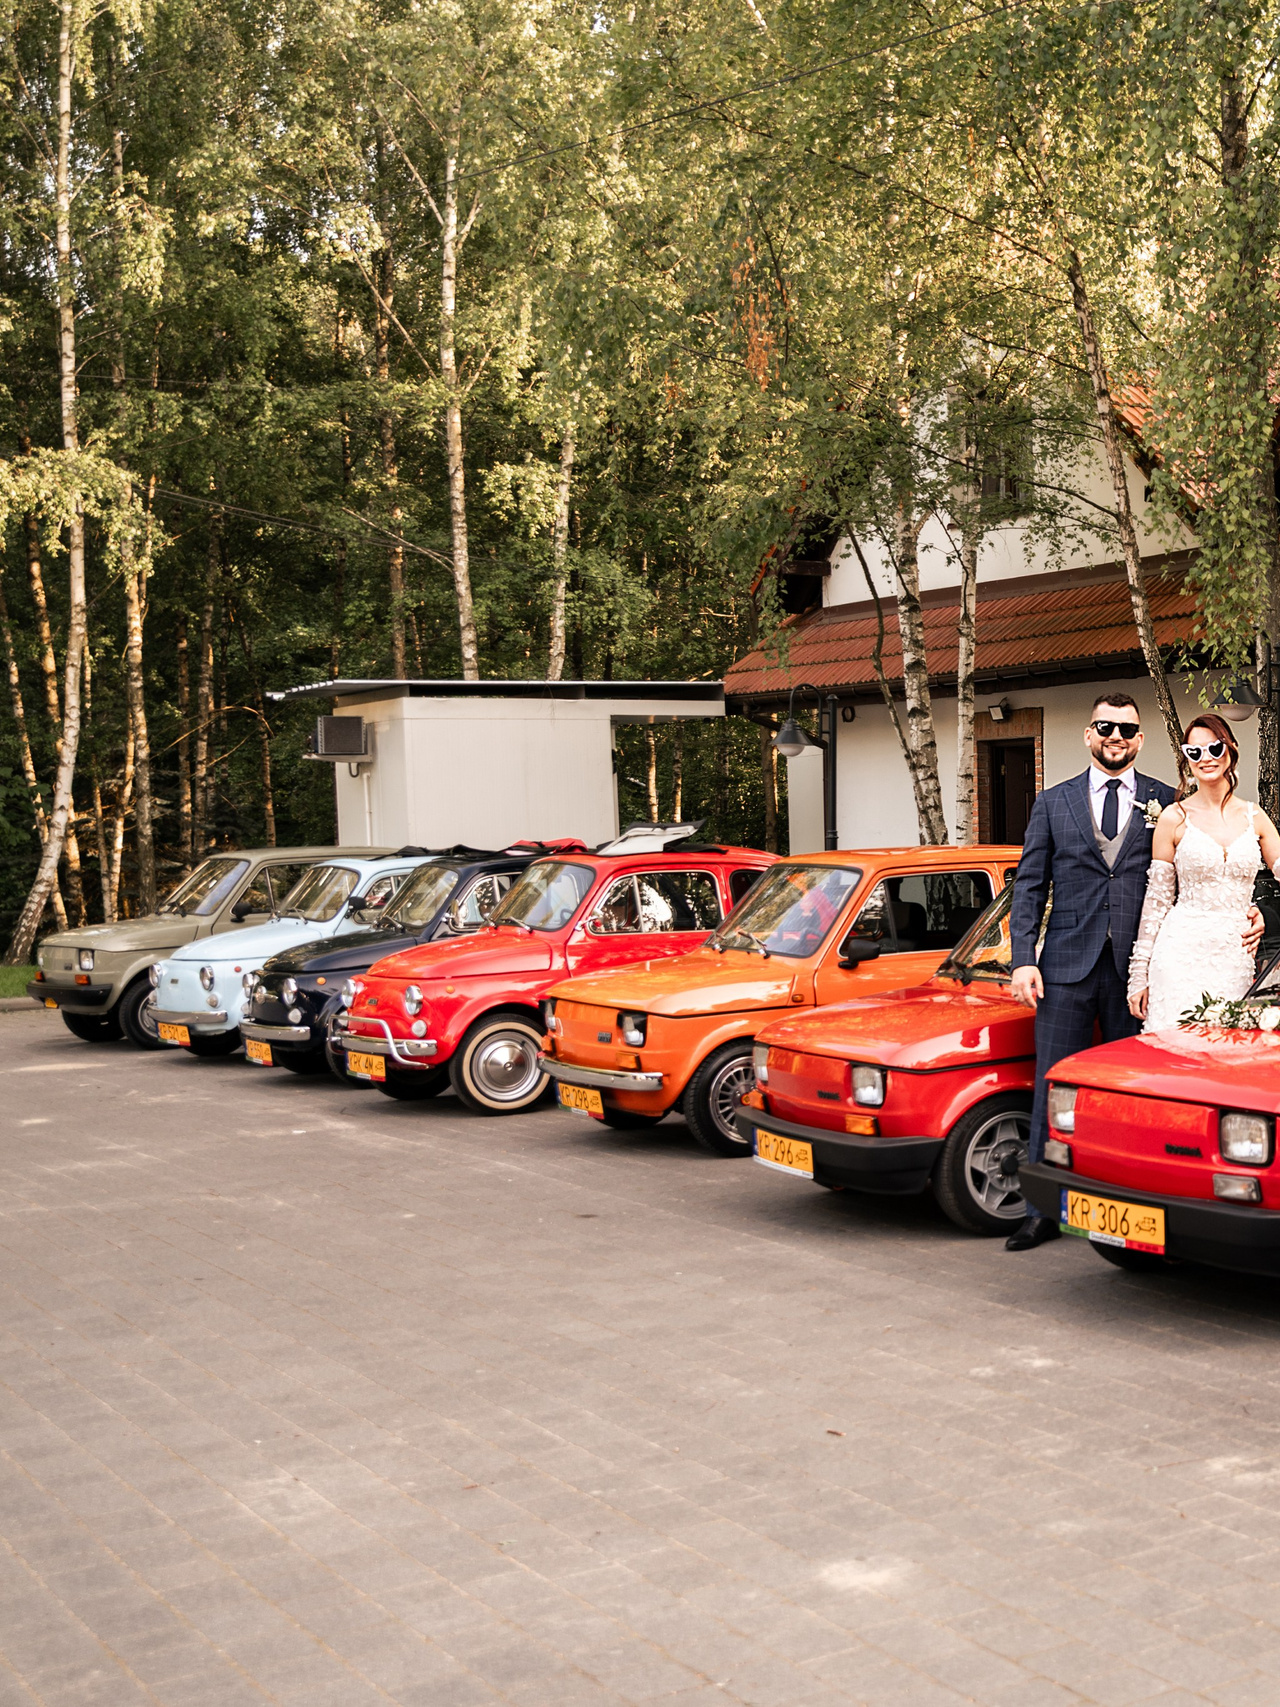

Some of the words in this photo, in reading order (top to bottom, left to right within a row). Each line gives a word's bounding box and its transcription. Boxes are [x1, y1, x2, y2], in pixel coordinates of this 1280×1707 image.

[572, 1088, 590, 1109] 298
[759, 1132, 772, 1159] KR
[773, 1137, 794, 1165] 296
[1070, 1194, 1091, 1229] KR
[1097, 1202, 1131, 1237] 306
